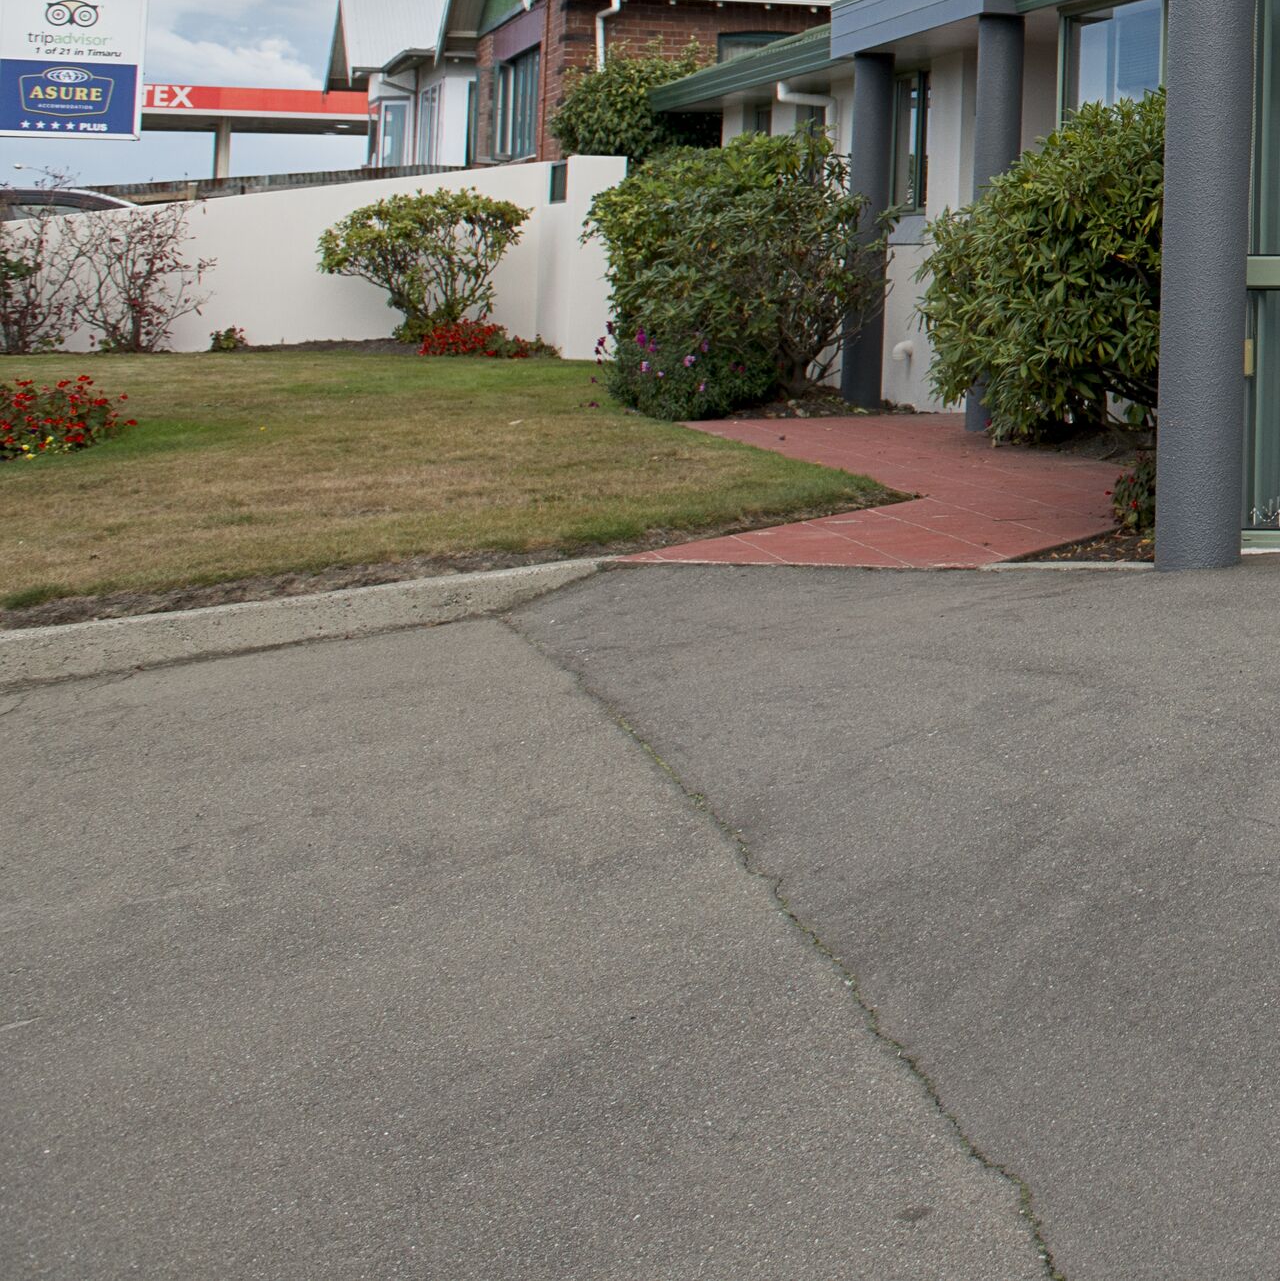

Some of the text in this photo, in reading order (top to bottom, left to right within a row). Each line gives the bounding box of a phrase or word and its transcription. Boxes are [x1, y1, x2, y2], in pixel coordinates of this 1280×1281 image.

[27, 32, 110, 46] tripadvisor
[45, 47, 56, 55] of
[58, 47, 71, 55] 21
[74, 47, 84, 55] in
[87, 49, 122, 57] Timaru
[29, 85, 103, 102] ASURE
[79, 122, 109, 132] PLUS
